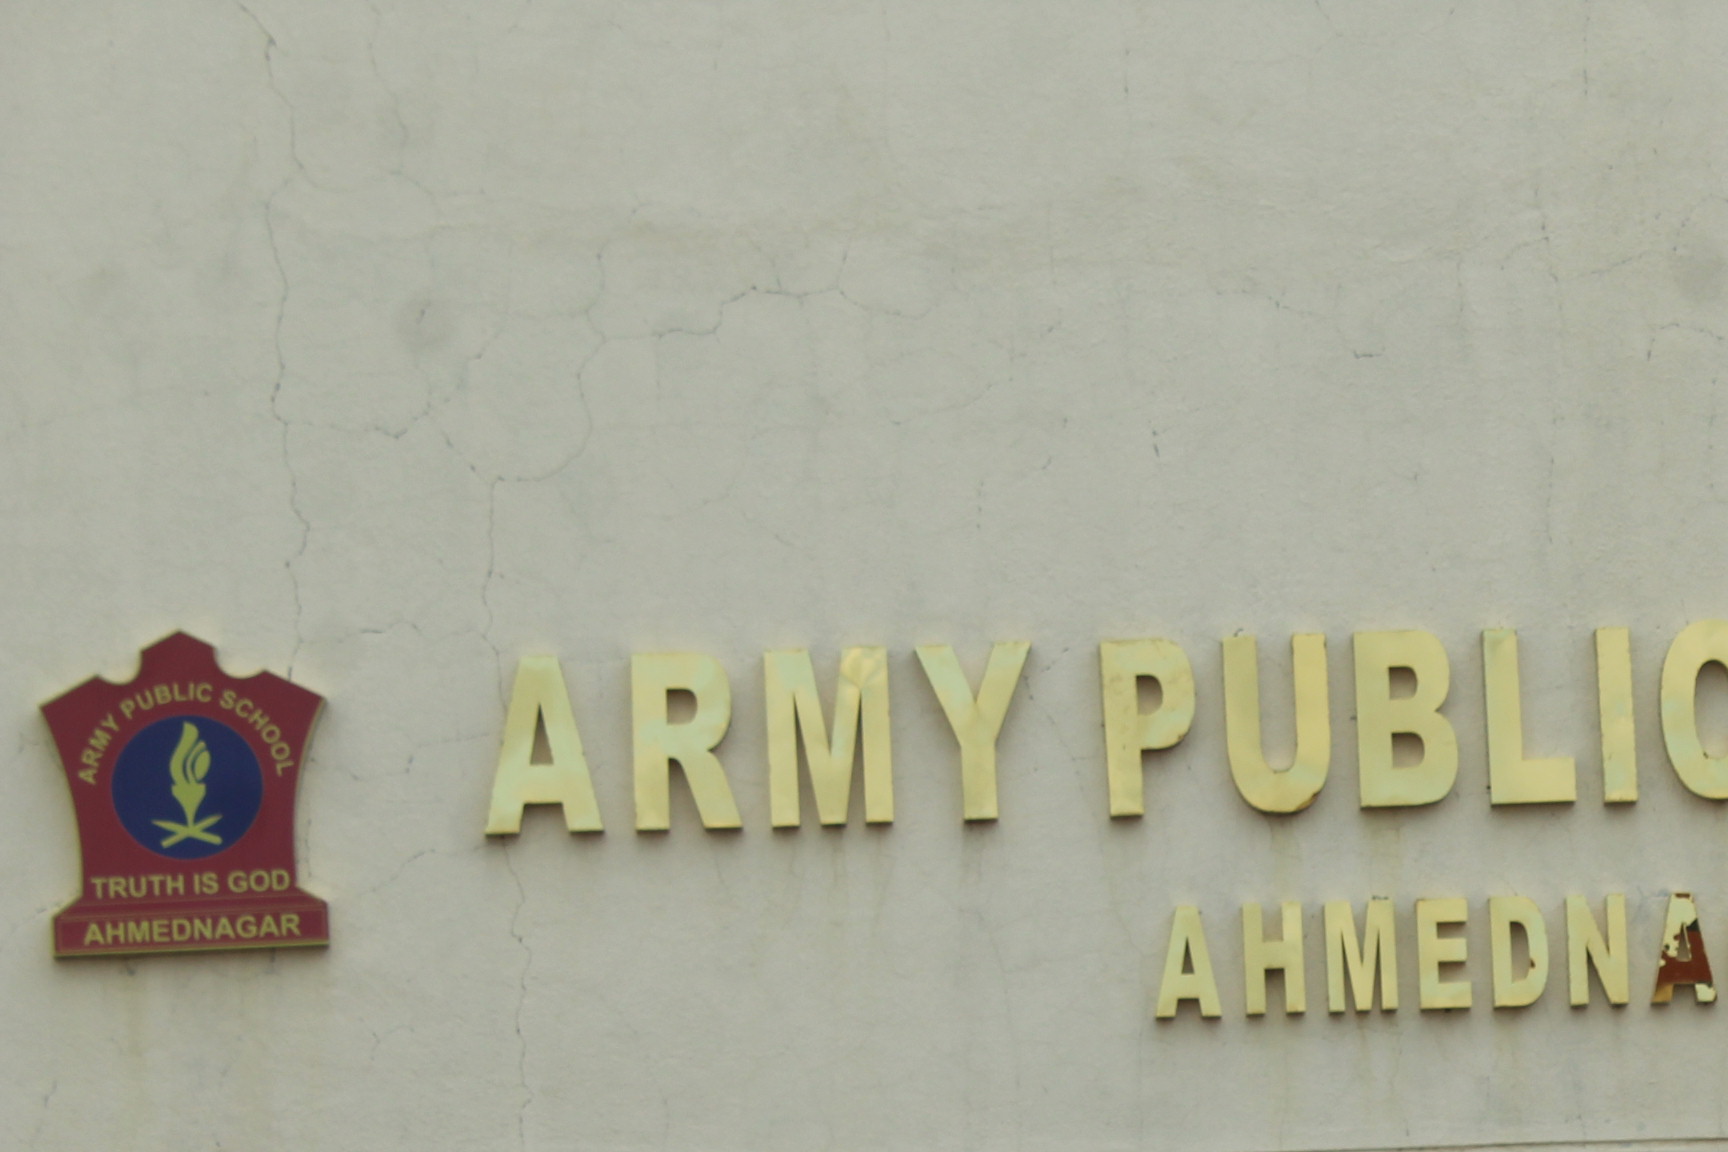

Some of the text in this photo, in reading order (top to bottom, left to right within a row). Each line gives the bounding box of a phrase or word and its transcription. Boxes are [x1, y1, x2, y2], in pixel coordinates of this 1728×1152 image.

[77, 682, 295, 785] ARMY PUBLIC SCHOOL
[485, 638, 1031, 836] ARMY
[91, 868, 290, 899] TRUTH IS GOD
[84, 913, 300, 946] AHMEDNAGAR
